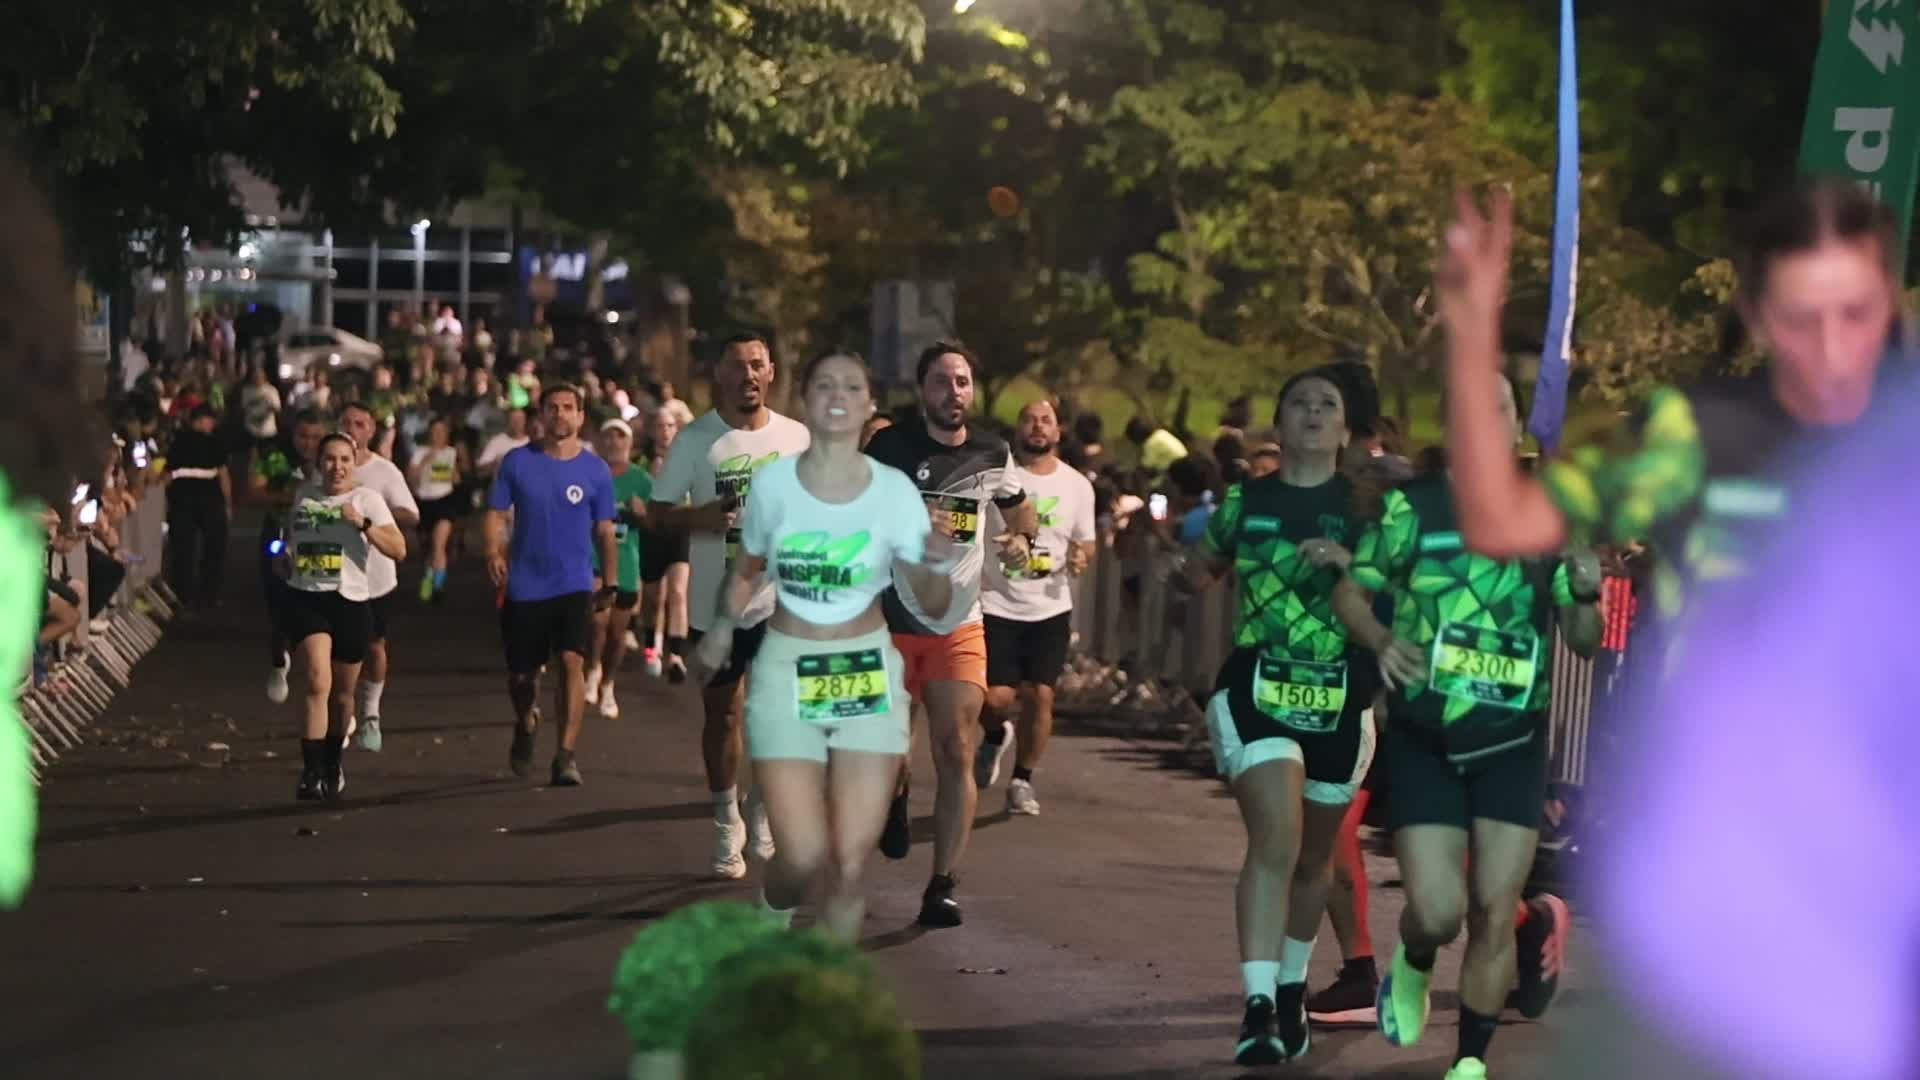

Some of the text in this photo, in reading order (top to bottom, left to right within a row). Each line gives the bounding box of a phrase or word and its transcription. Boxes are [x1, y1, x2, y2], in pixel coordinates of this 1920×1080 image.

[776, 562, 852, 587] INSPIRA
[1455, 649, 1516, 680] 2300
[813, 671, 874, 699] 2873
[1273, 683, 1331, 708] 1503
